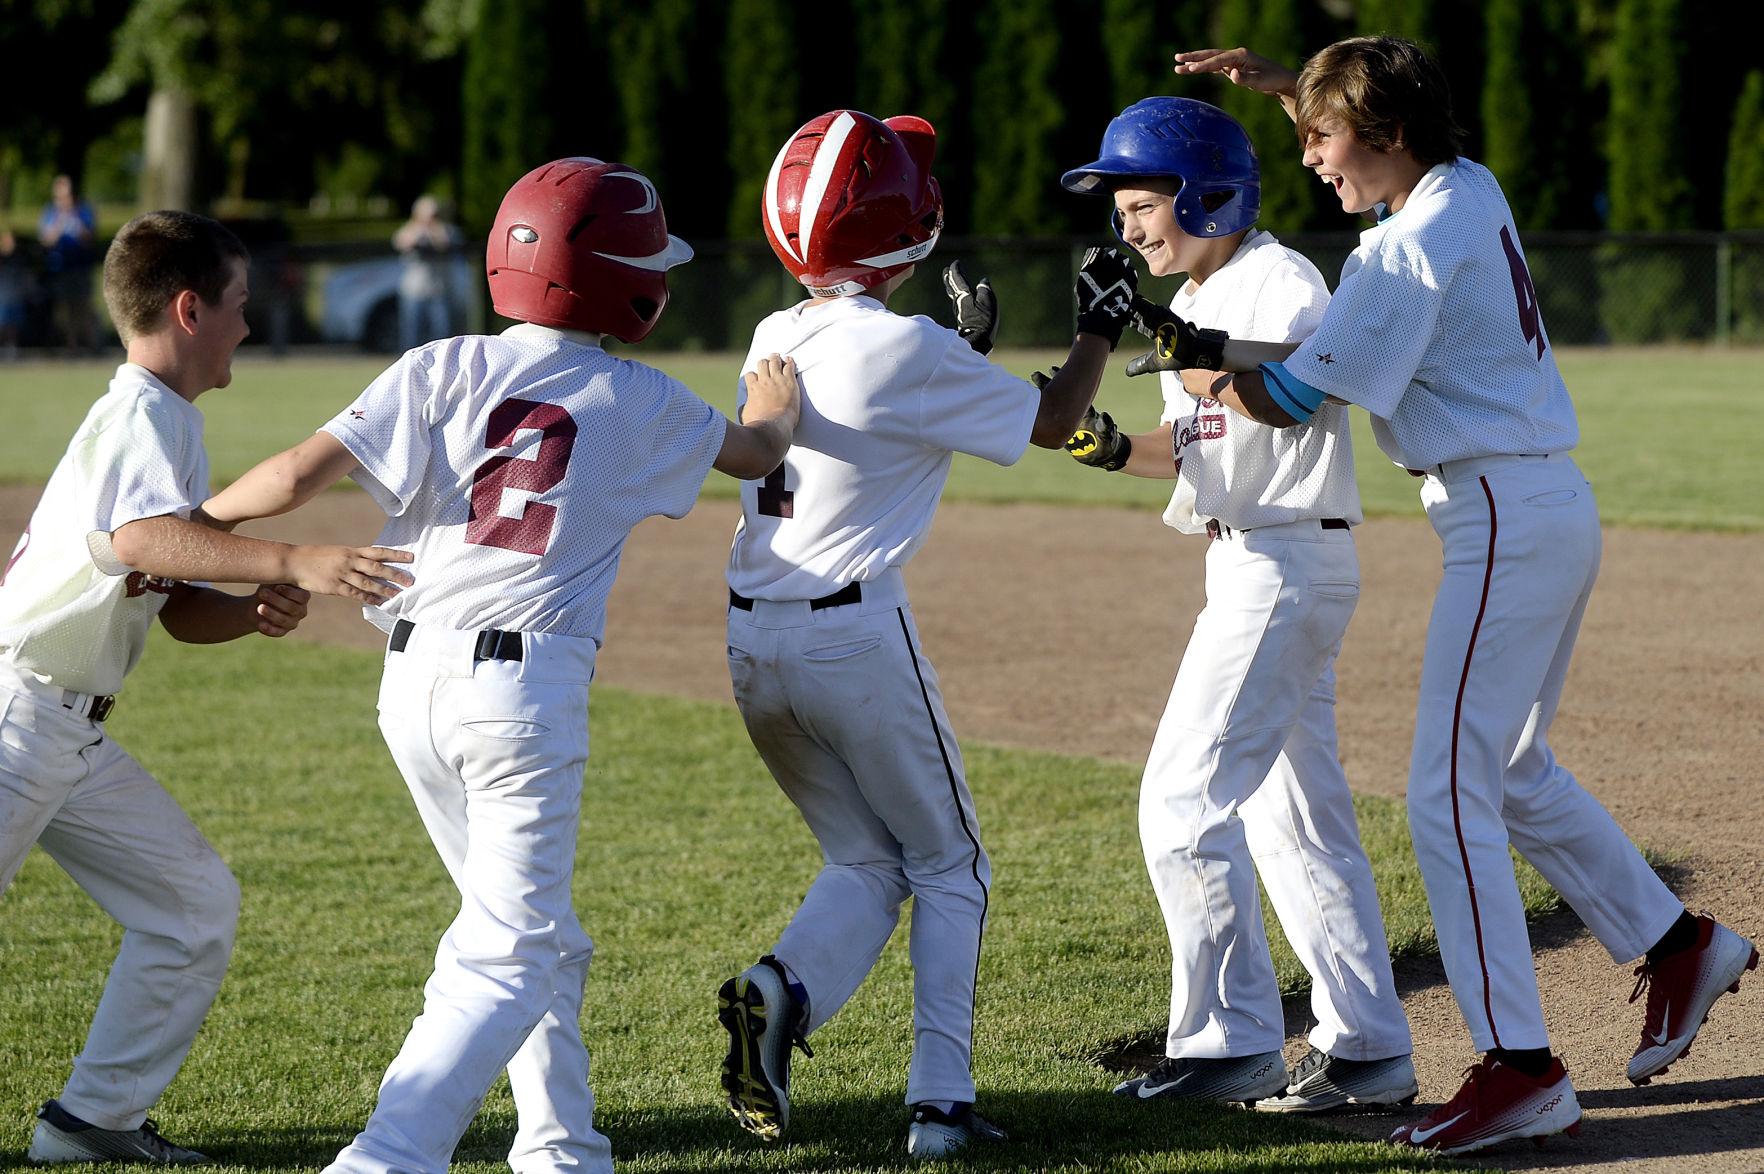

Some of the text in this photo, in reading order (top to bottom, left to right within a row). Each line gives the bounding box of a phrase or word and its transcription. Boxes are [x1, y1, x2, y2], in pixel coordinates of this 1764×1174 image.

[907, 244, 927, 258] schutt
[1499, 224, 1546, 362] 4
[464, 398, 577, 556] 2
[1250, 1062, 1274, 1080] vapor
[1536, 1094, 1563, 1115] vapor
